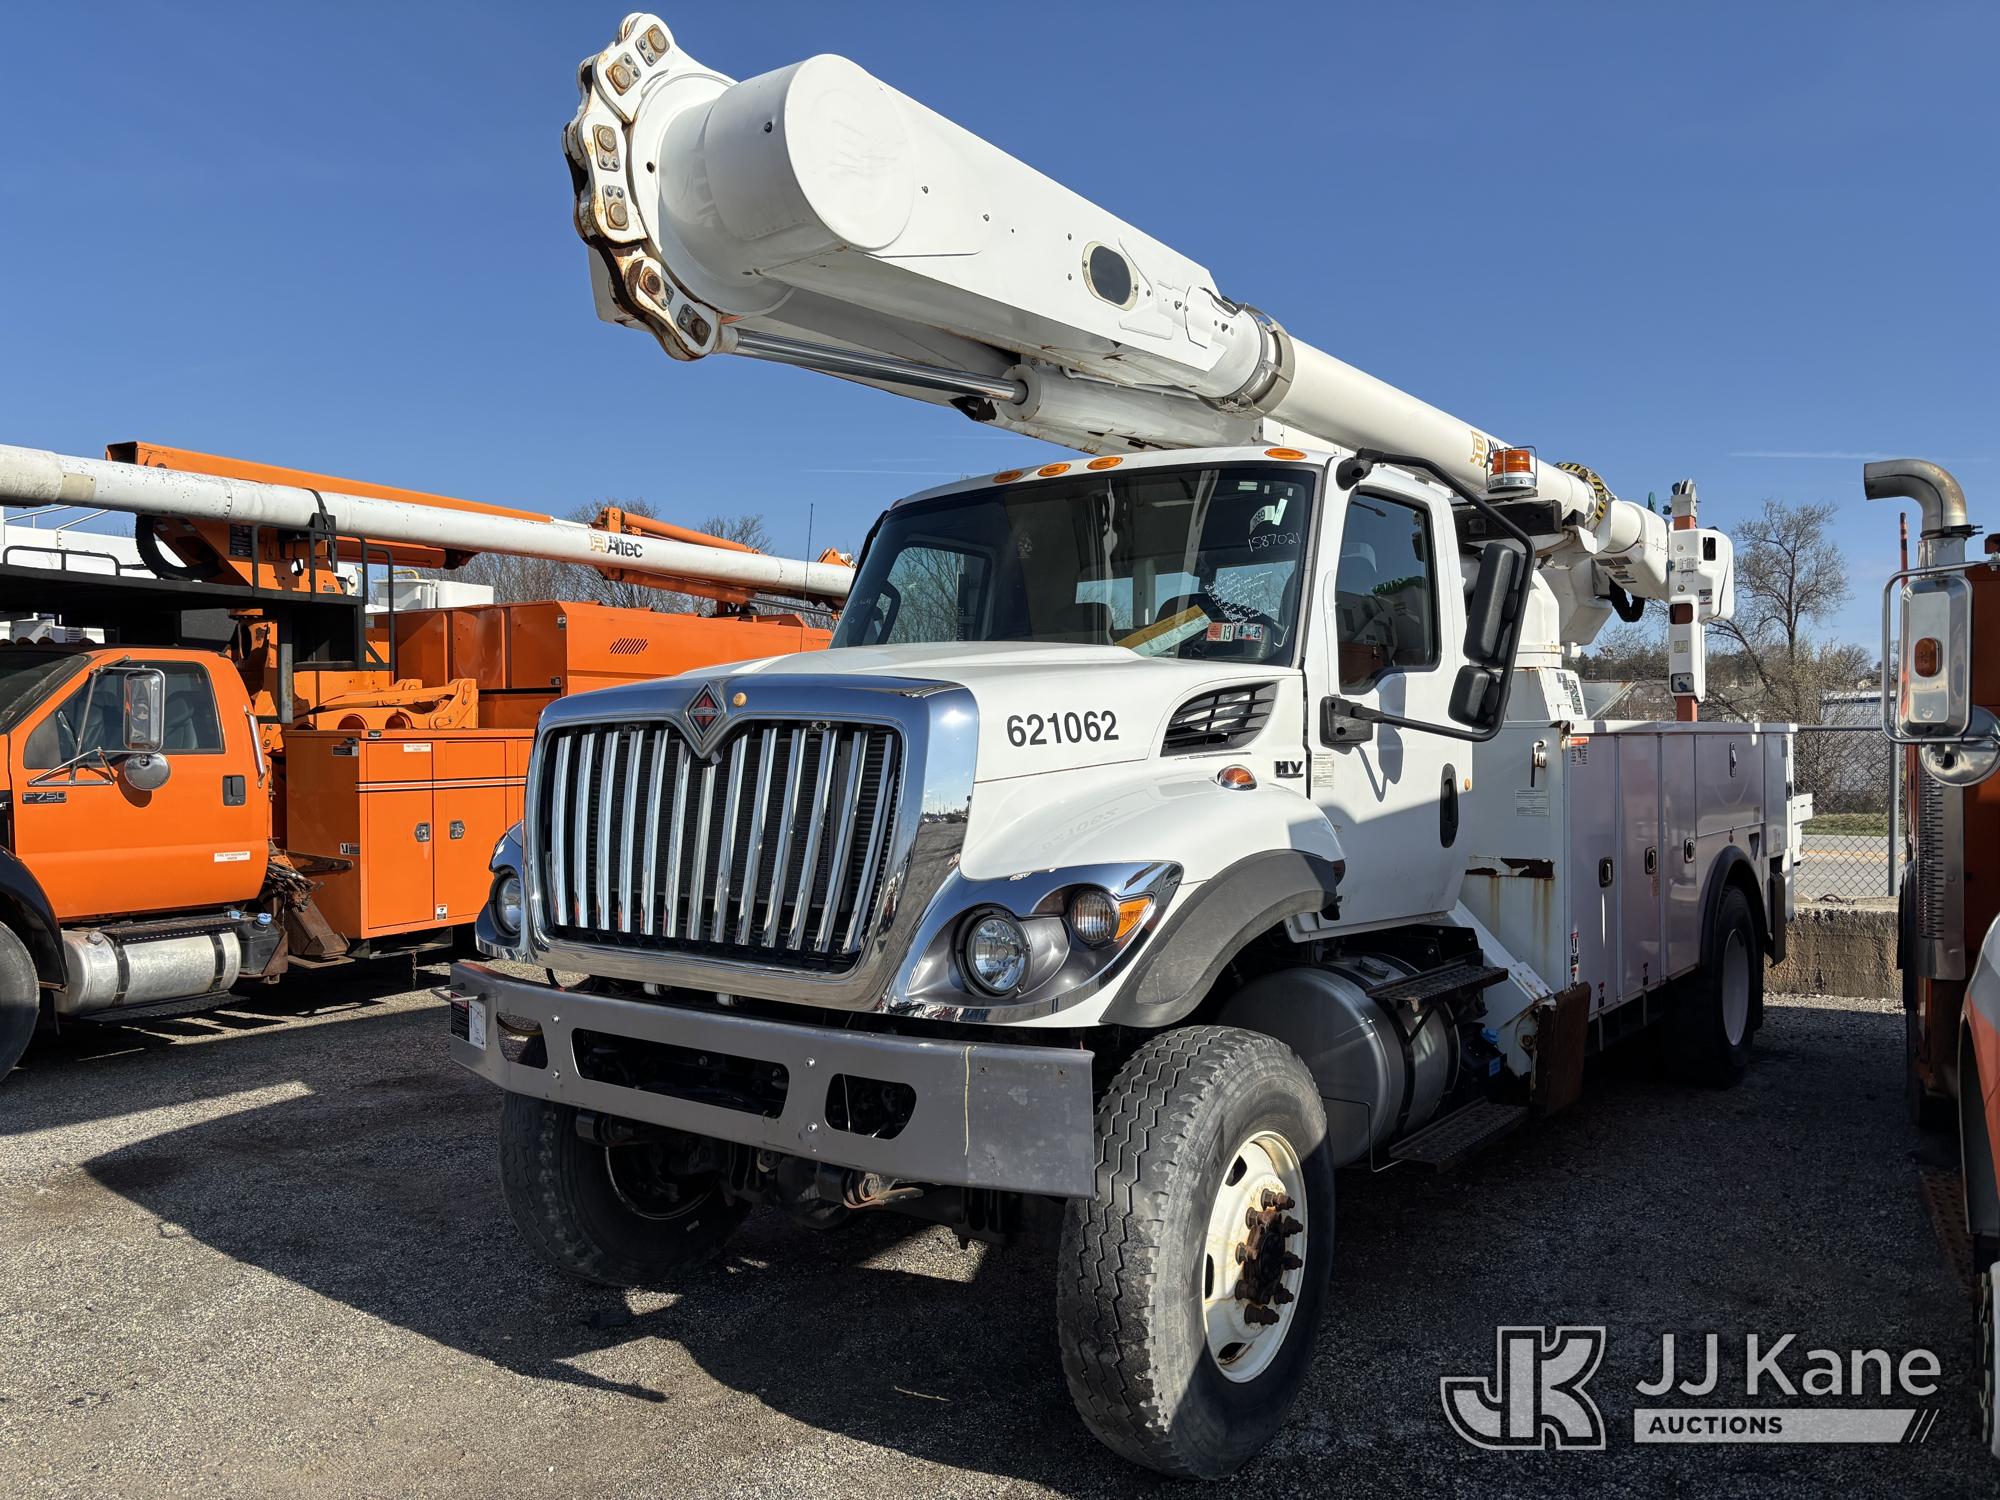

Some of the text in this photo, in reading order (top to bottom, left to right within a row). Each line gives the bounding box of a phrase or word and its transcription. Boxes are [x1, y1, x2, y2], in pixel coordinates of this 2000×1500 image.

[1223, 624, 1232, 640] 13
[1007, 710, 1119, 747] 621062
[1275, 761, 1303, 773] HV
